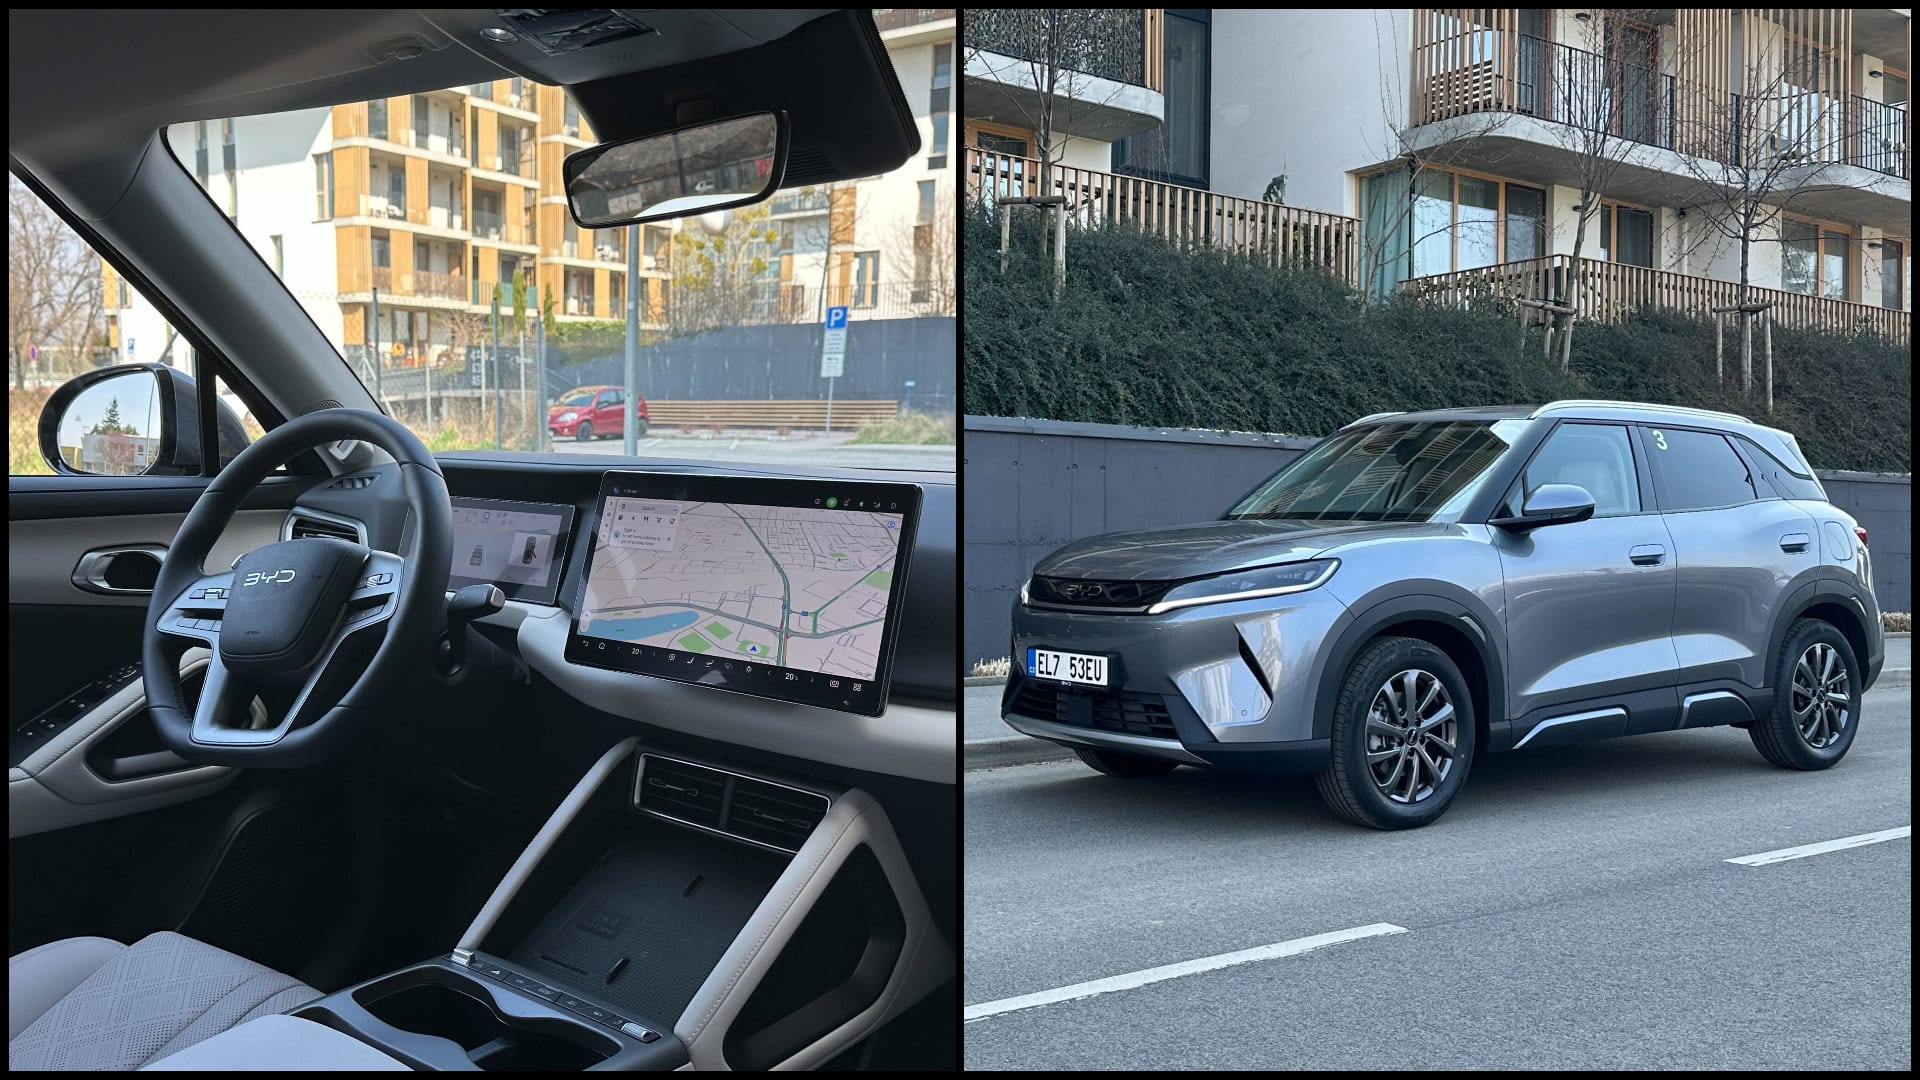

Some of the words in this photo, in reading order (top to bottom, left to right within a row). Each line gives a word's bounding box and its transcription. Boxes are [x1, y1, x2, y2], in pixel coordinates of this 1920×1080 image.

[830, 309, 843, 327] P
[1652, 429, 1668, 450] 3
[243, 569, 296, 587] BYD
[785, 672, 795, 680] 20
[1038, 652, 1060, 677] EL7
[1069, 656, 1102, 682] 53EU
